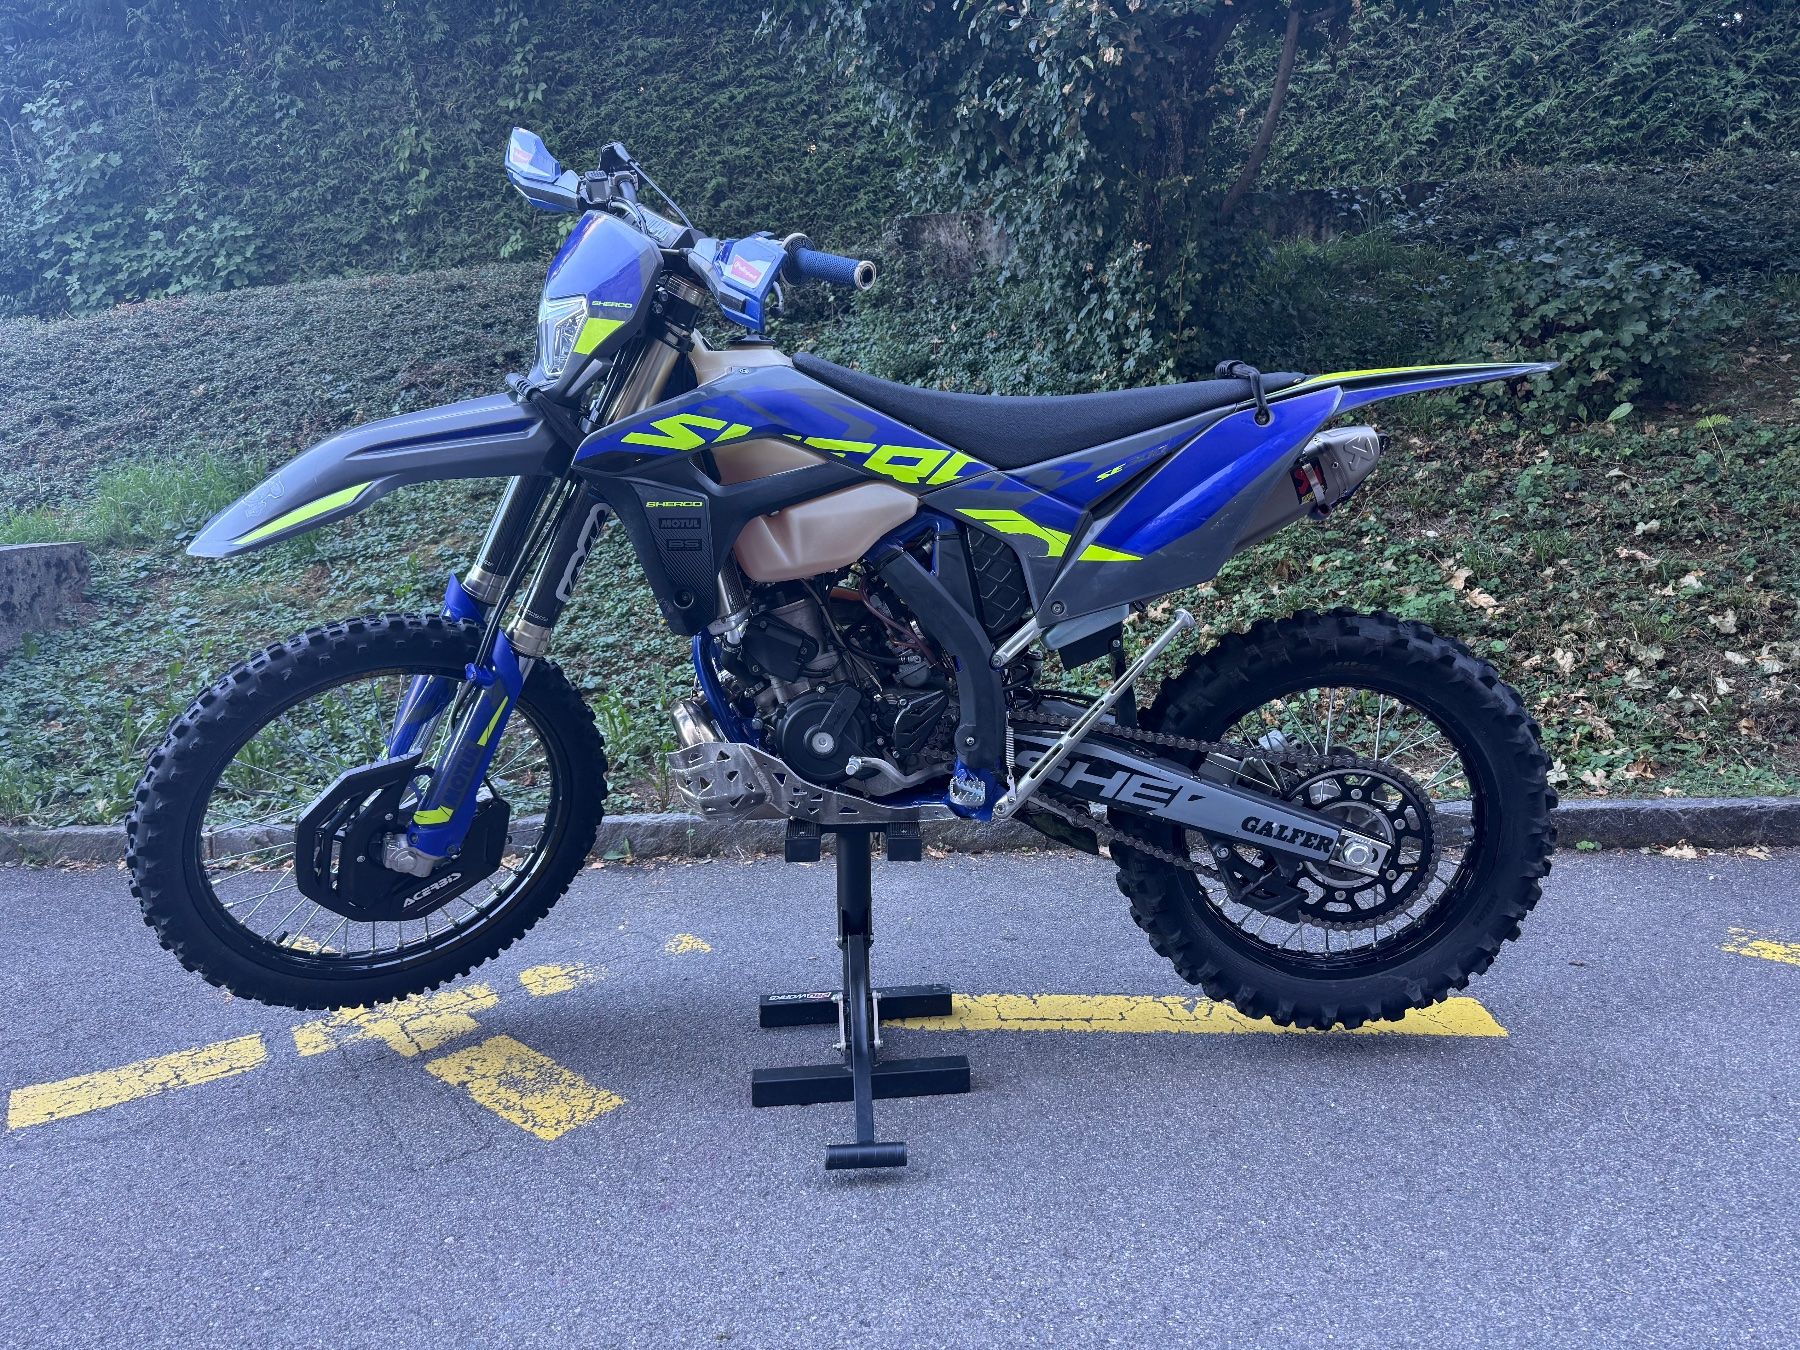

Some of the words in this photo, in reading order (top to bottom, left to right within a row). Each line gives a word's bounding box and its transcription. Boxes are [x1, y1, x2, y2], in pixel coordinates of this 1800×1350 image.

[1096, 463, 1126, 483] SE
[661, 520, 700, 528] MOTUL
[1241, 816, 1334, 854] GALFER
[403, 873, 462, 908] ACERBIS
